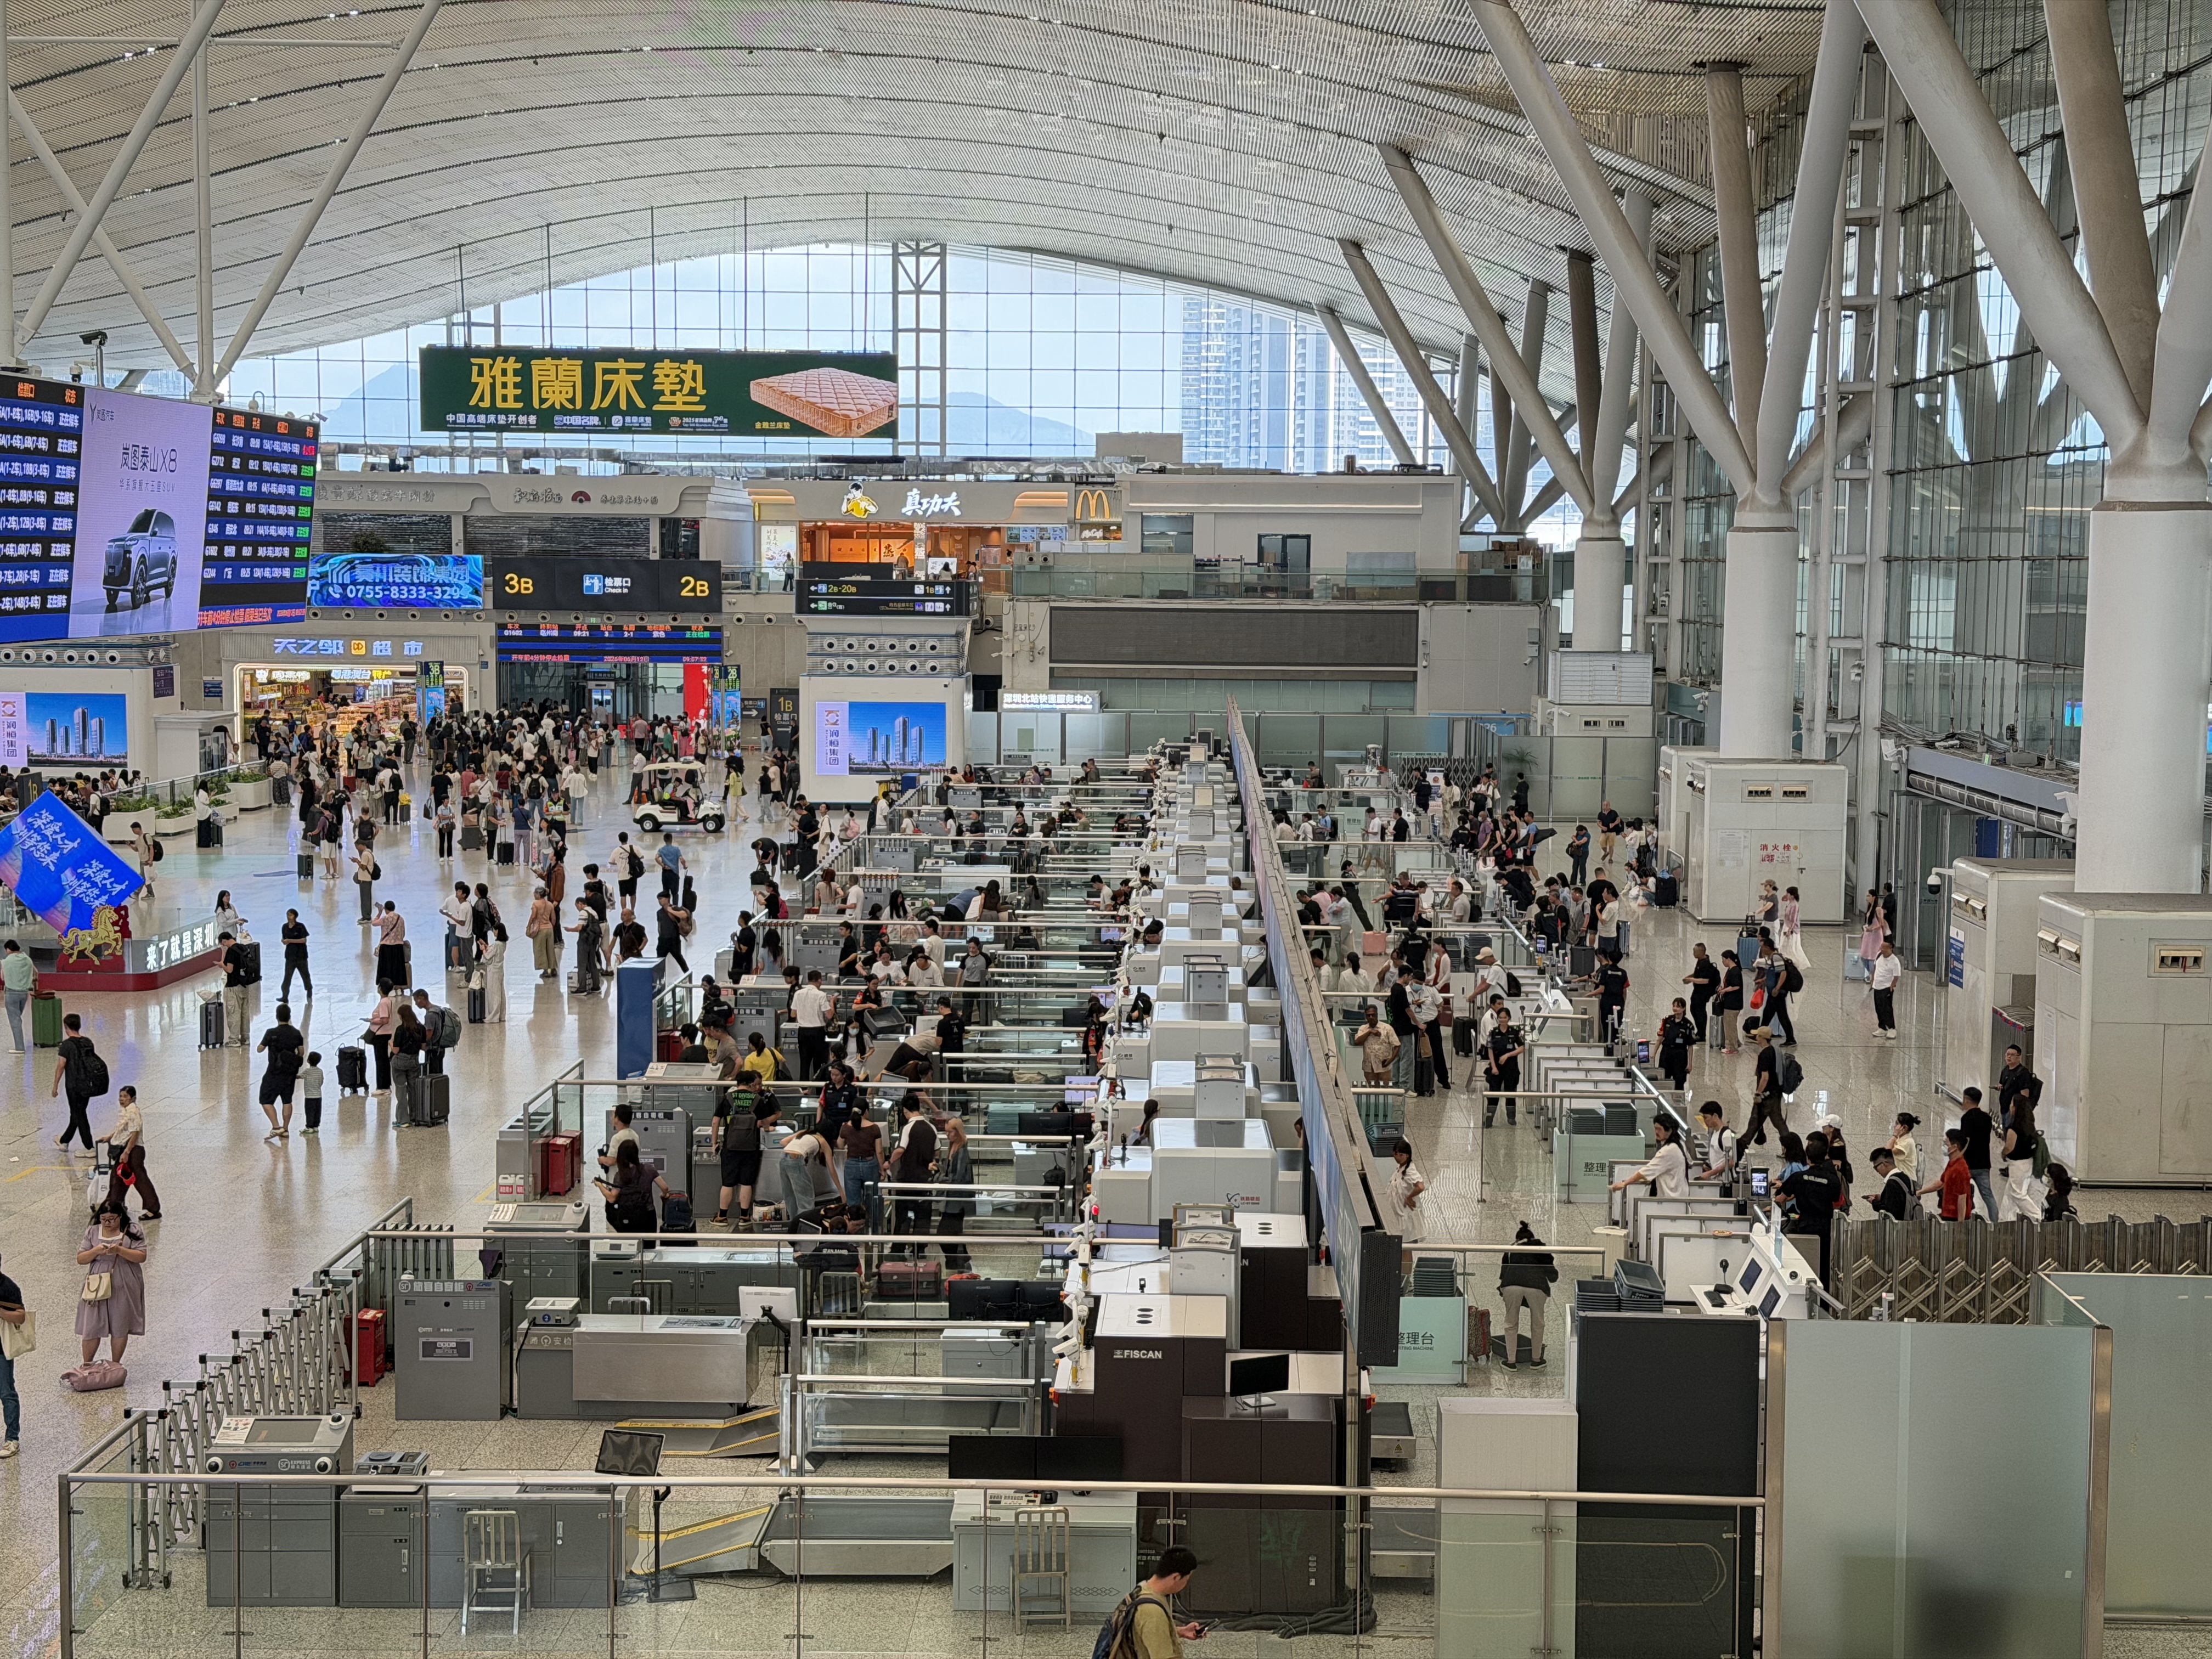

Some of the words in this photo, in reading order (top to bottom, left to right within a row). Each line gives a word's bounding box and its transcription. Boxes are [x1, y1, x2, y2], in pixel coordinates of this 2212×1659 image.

[469, 356, 707, 411] 雅蘭床墊
[446, 413, 537, 425] 中国高端床垫开创者
[564, 416, 600, 425] 中国名牌
[755, 421, 791, 430] 金雅兰床垫
[120, 442, 177, 473] 岚图泰山X8
[901, 488, 962, 517] 真功夫
[504, 573, 534, 594] 3B
[605, 577, 631, 586] 检票口
[680, 575, 709, 597] 2B
[828, 584, 857, 593] 2B-20B
[925, 585, 934, 594] 1B
[273, 638, 345, 655] 天之邻
[373, 640, 423, 656] 超市
[728, 669, 737, 679] 2B
[778, 696, 793, 712] 1B
[7, 720, 18, 758] 润恒集团
[829, 729, 839, 765] 润恒集团
[1759, 843, 1791, 851] 消火栓
[146, 922, 218, 970] 来了就是深圳
[1583, 1161, 1609, 1173] 整理
[553, 1336, 572, 1346] 安检
[1124, 1350, 1163, 1359] FISCAN
